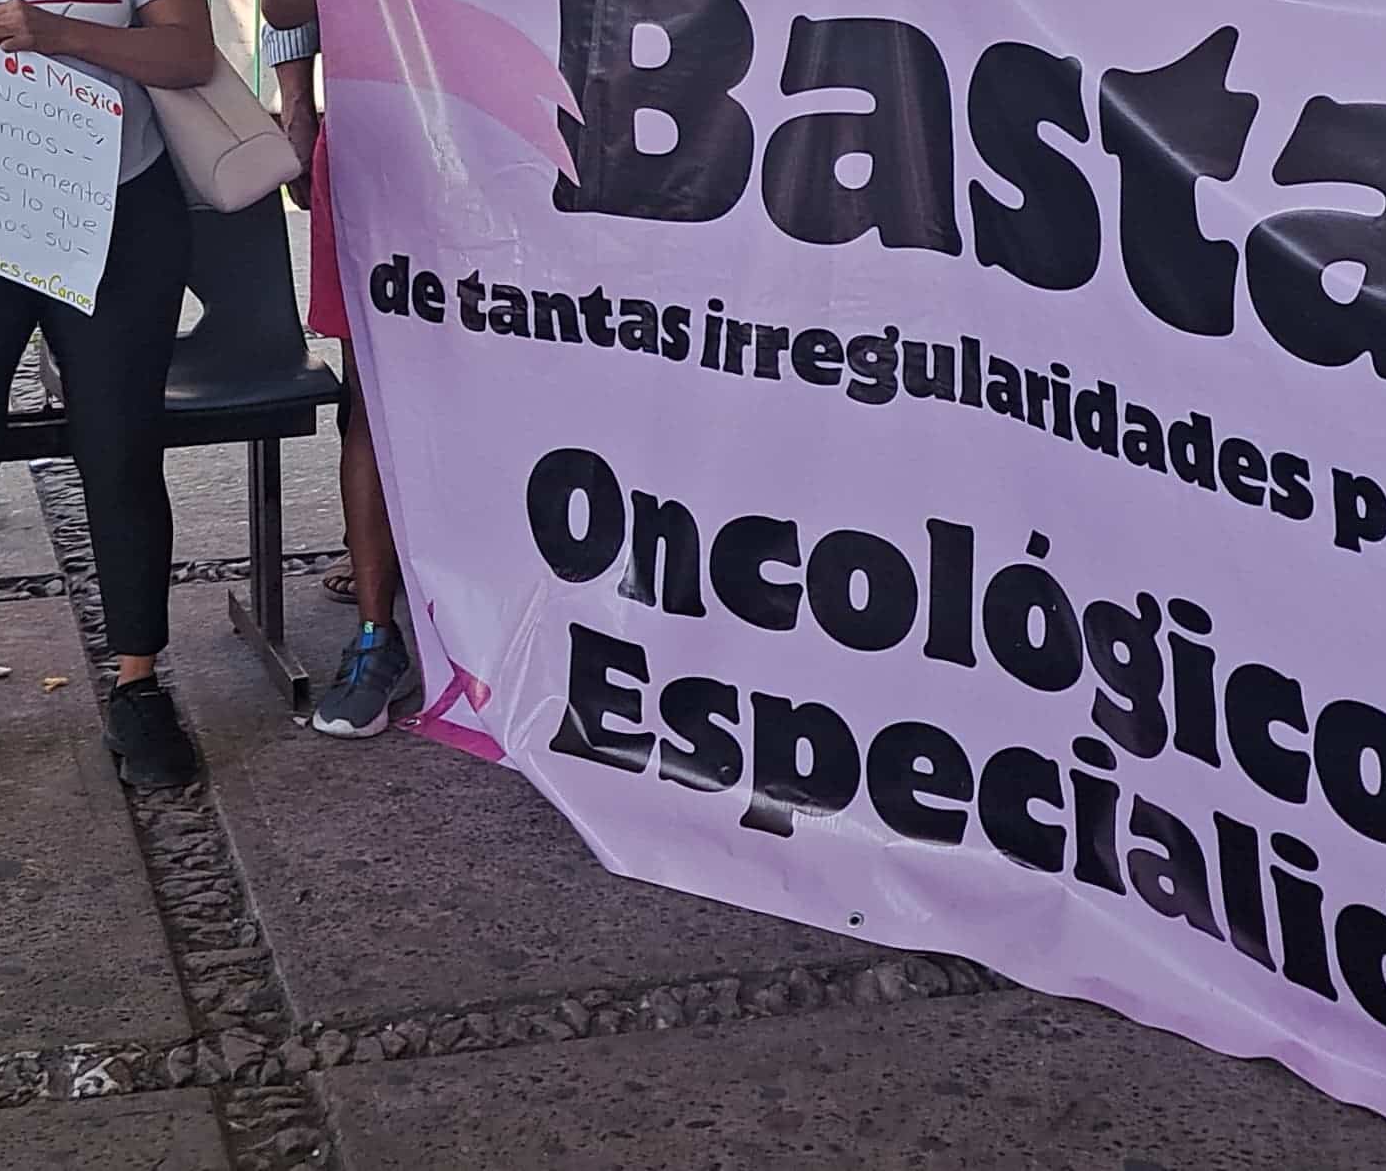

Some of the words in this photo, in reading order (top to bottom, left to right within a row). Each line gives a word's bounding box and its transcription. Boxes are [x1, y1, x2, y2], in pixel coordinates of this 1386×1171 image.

[4, 50, 38, 83] de
[45, 63, 123, 117] México
[21, 187, 44, 211] lo
[52, 206, 98, 236] que
[23, 270, 47, 290] con
[369, 254, 446, 324] de
[457, 279, 691, 361] tantas
[701, 297, 1317, 521] irregularidades
